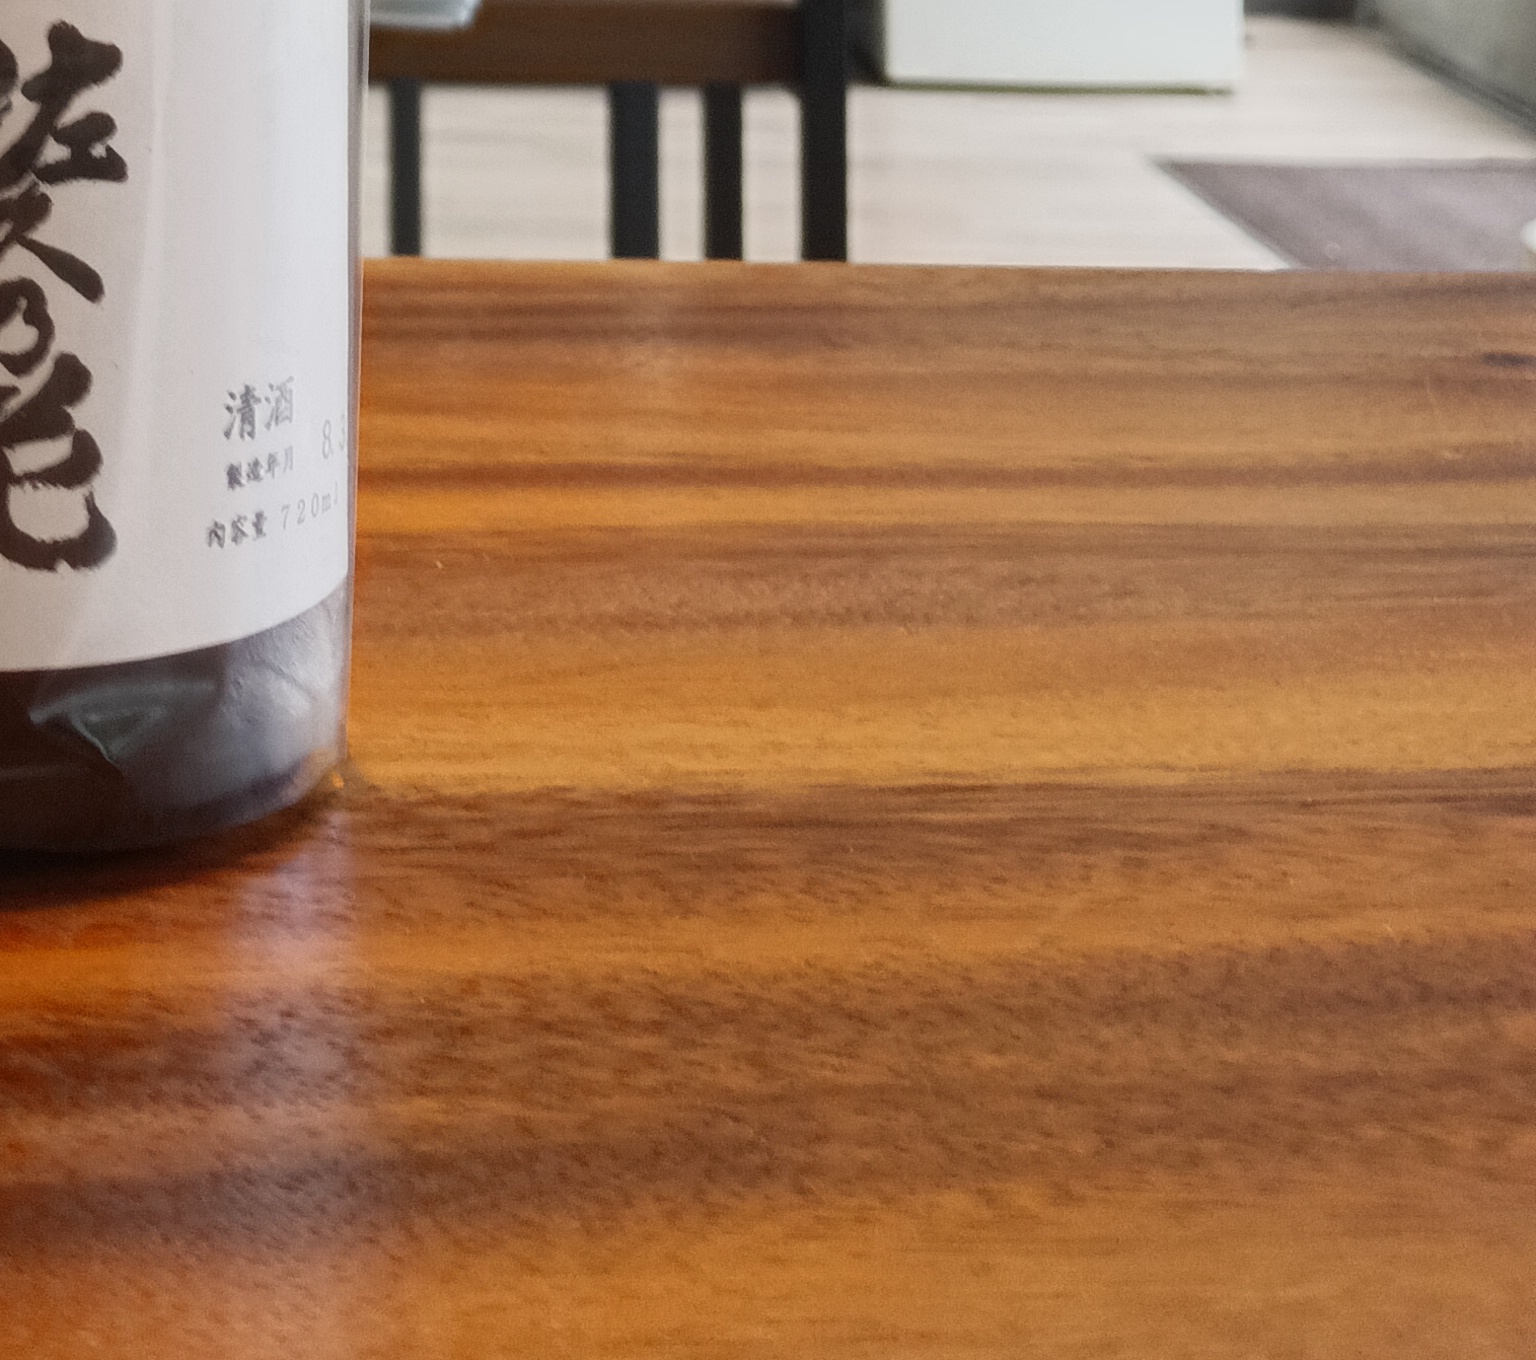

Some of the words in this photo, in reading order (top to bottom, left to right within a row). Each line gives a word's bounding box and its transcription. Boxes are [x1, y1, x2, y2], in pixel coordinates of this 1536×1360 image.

[222, 375, 294, 441] 清酒
[206, 509, 267, 549] 内容量
